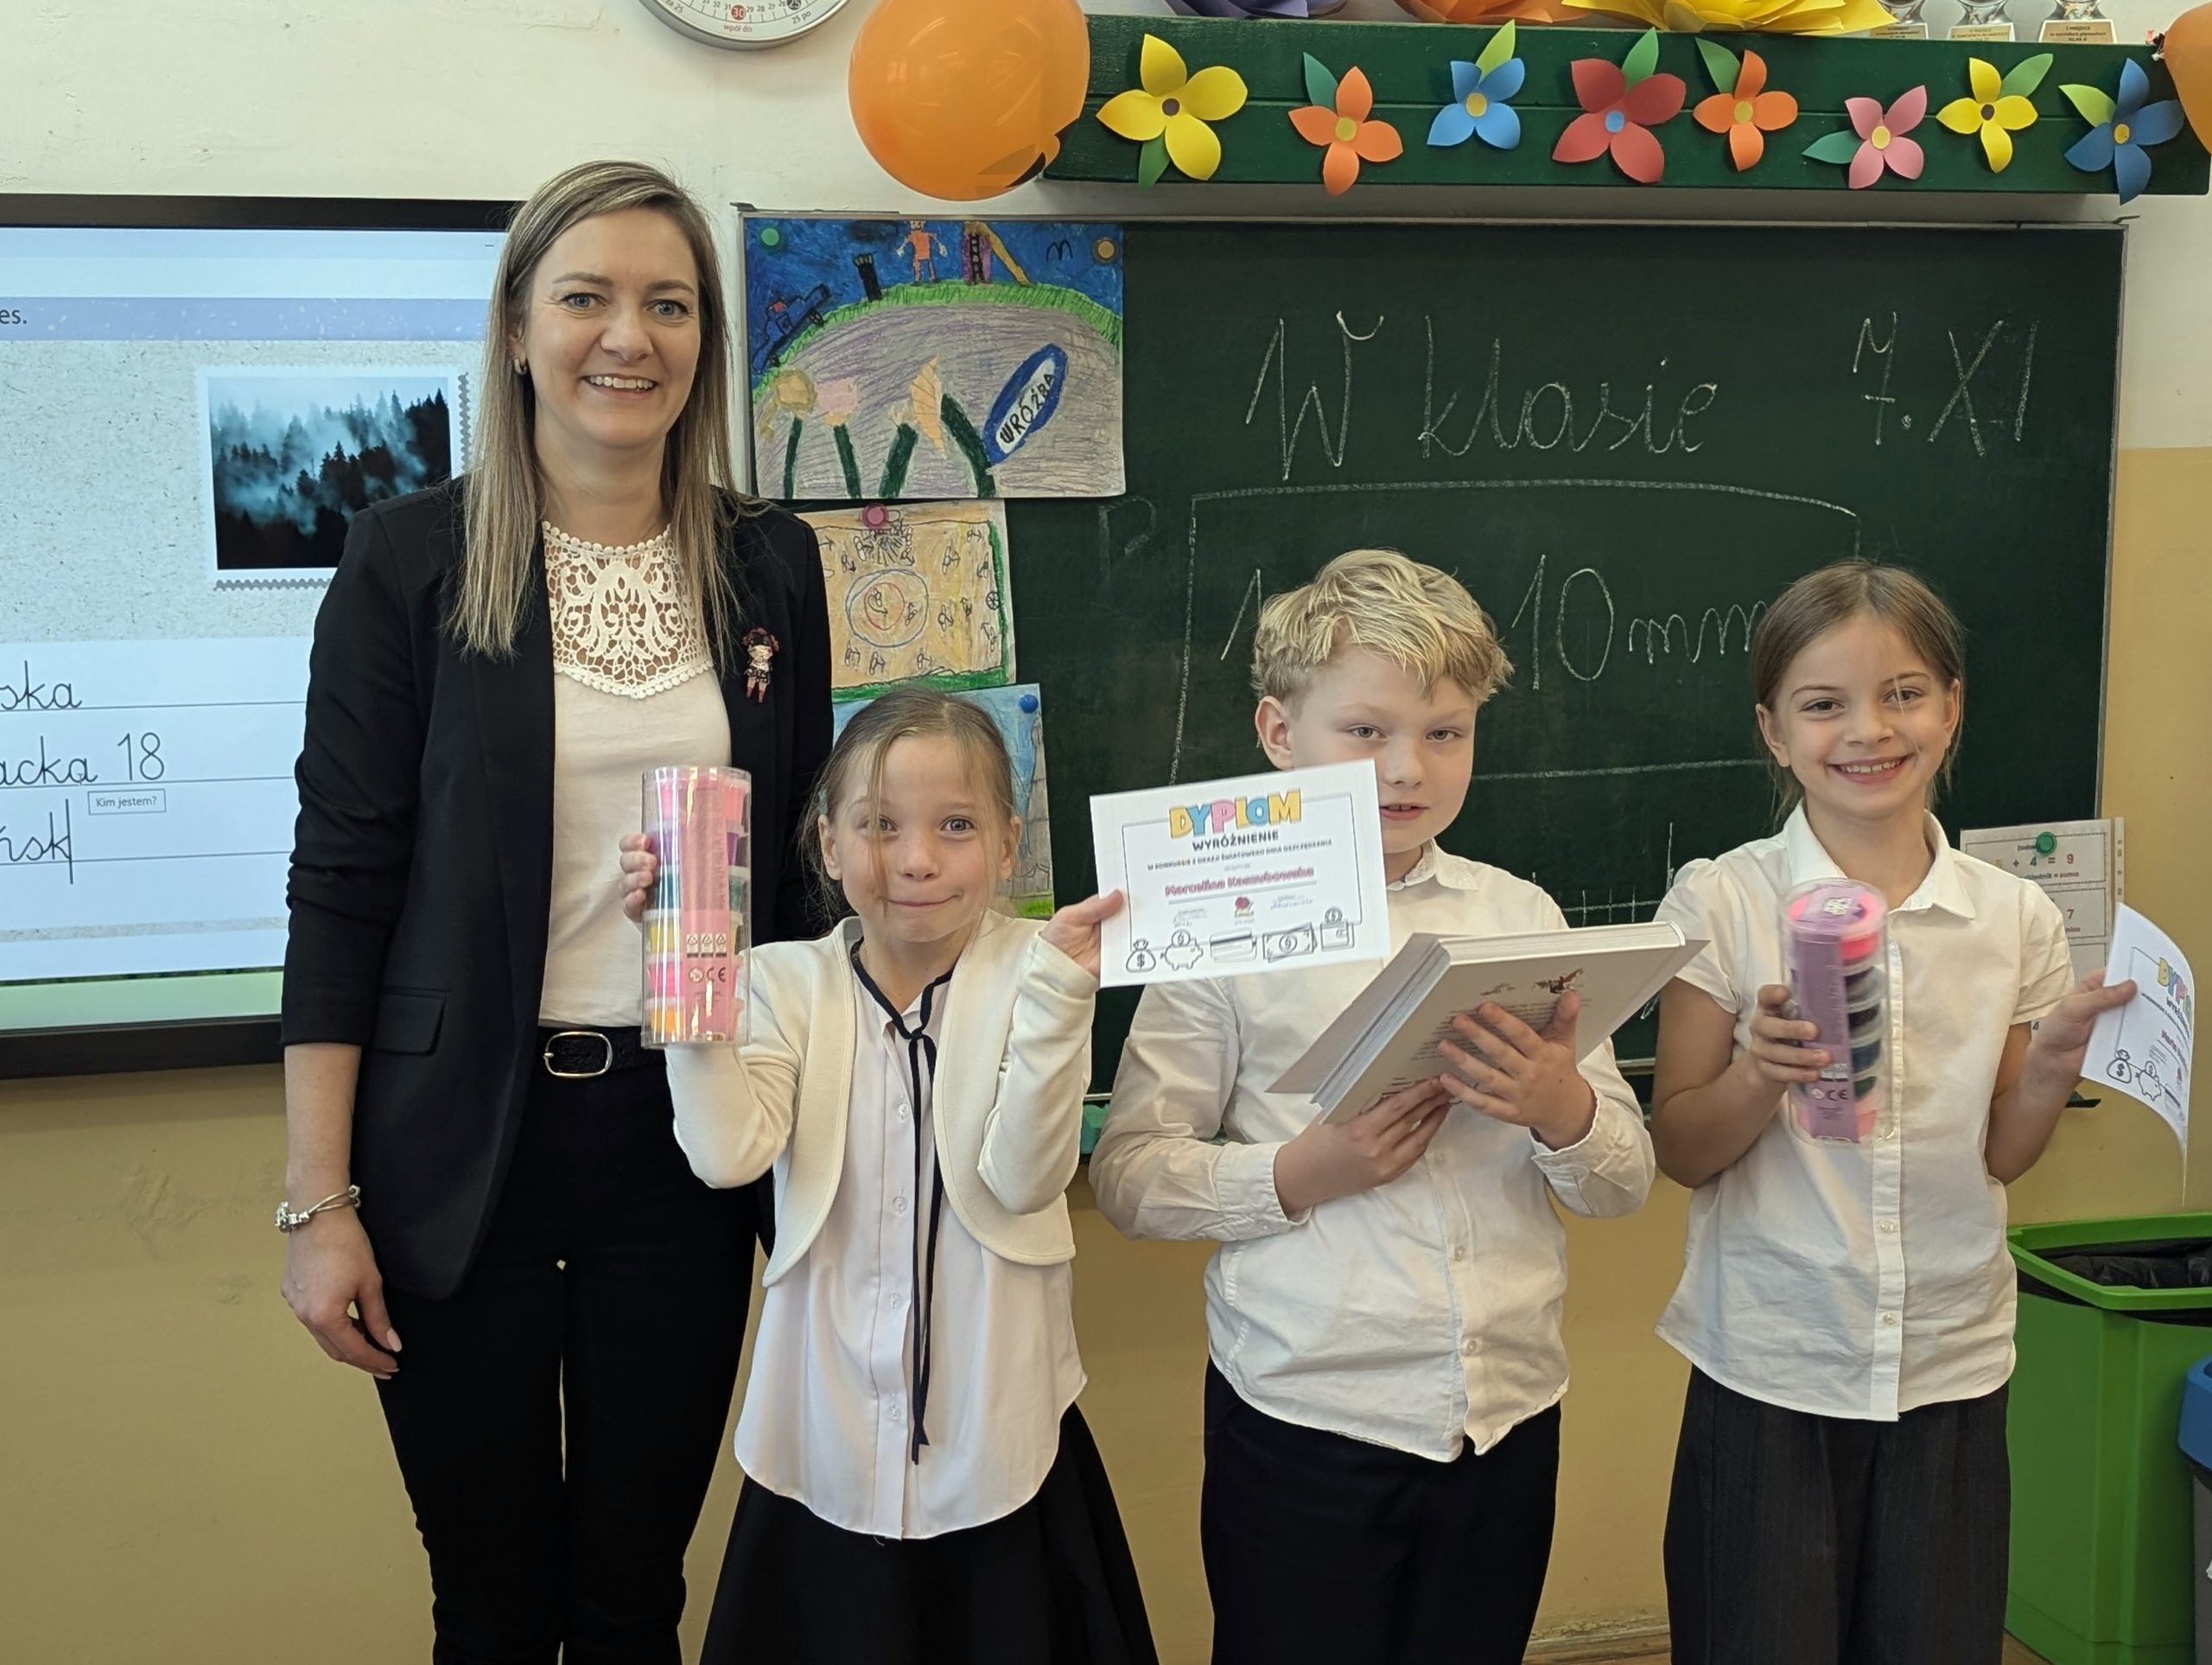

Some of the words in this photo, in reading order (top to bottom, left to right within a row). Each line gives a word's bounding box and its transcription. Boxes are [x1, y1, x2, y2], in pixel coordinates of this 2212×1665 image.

[675, 3, 684, 14] 25
[733, 6, 745, 19] 30
[791, 16, 801, 24] 25
[802, 11, 811, 21] po
[1244, 310, 1384, 481] W
[117, 732, 164, 781] 18
[96, 798, 116, 808] Kim
[118, 796, 157, 809] jestem?
[1169, 788, 1302, 840] DYPLOM
[1192, 829, 1280, 852] WYRÓŻNIENIE
[2029, 856, 2037, 867] 4
[2066, 854, 2075, 864] 9
[2066, 908, 2075, 920] 7
